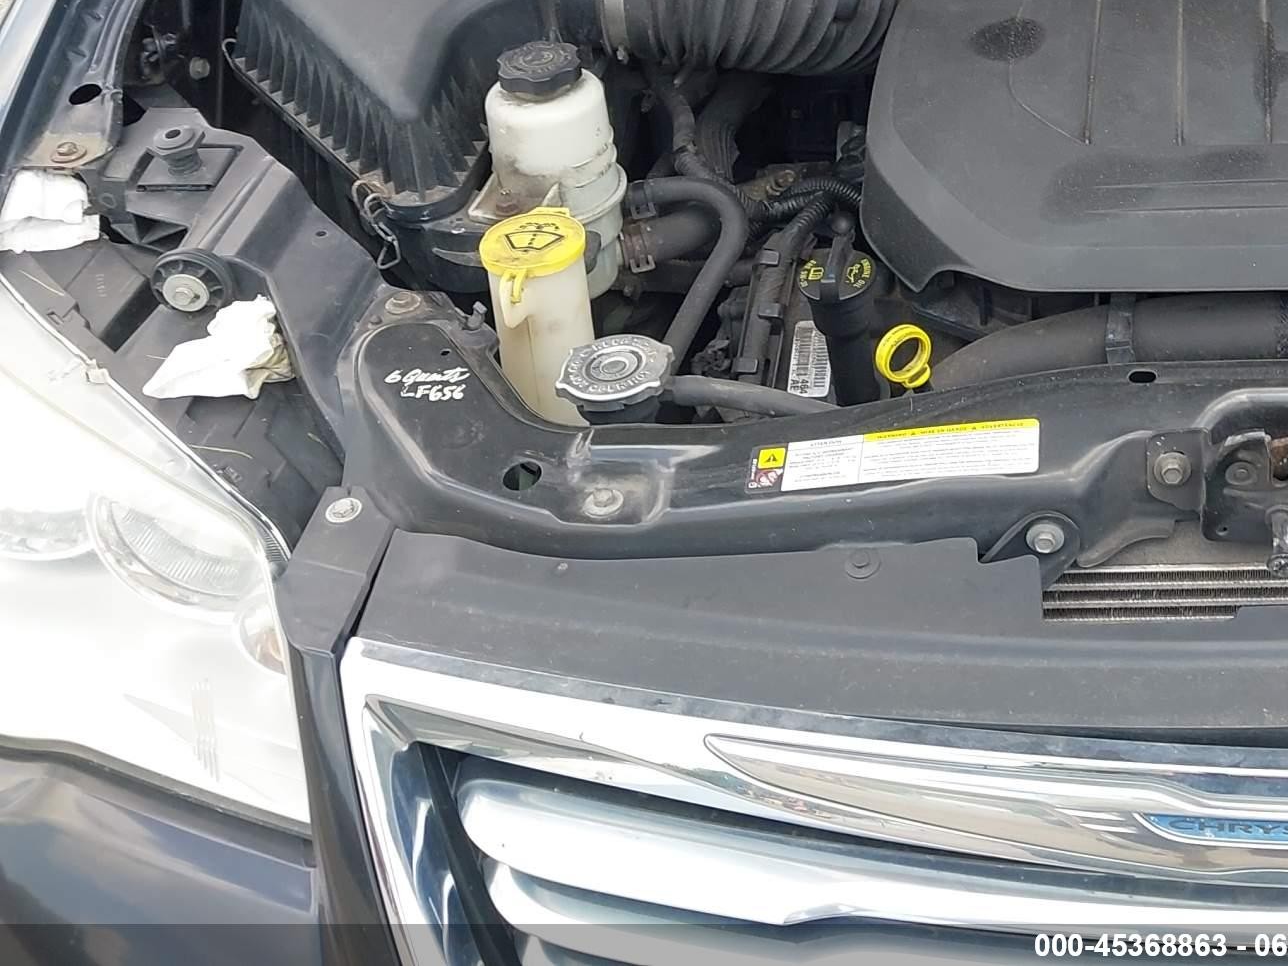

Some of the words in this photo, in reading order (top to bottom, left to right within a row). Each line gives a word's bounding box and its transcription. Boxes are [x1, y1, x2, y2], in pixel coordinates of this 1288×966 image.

[860, 258, 872, 279] ENGINE
[853, 279, 866, 289] OIL
[384, 369, 403, 383] 6
